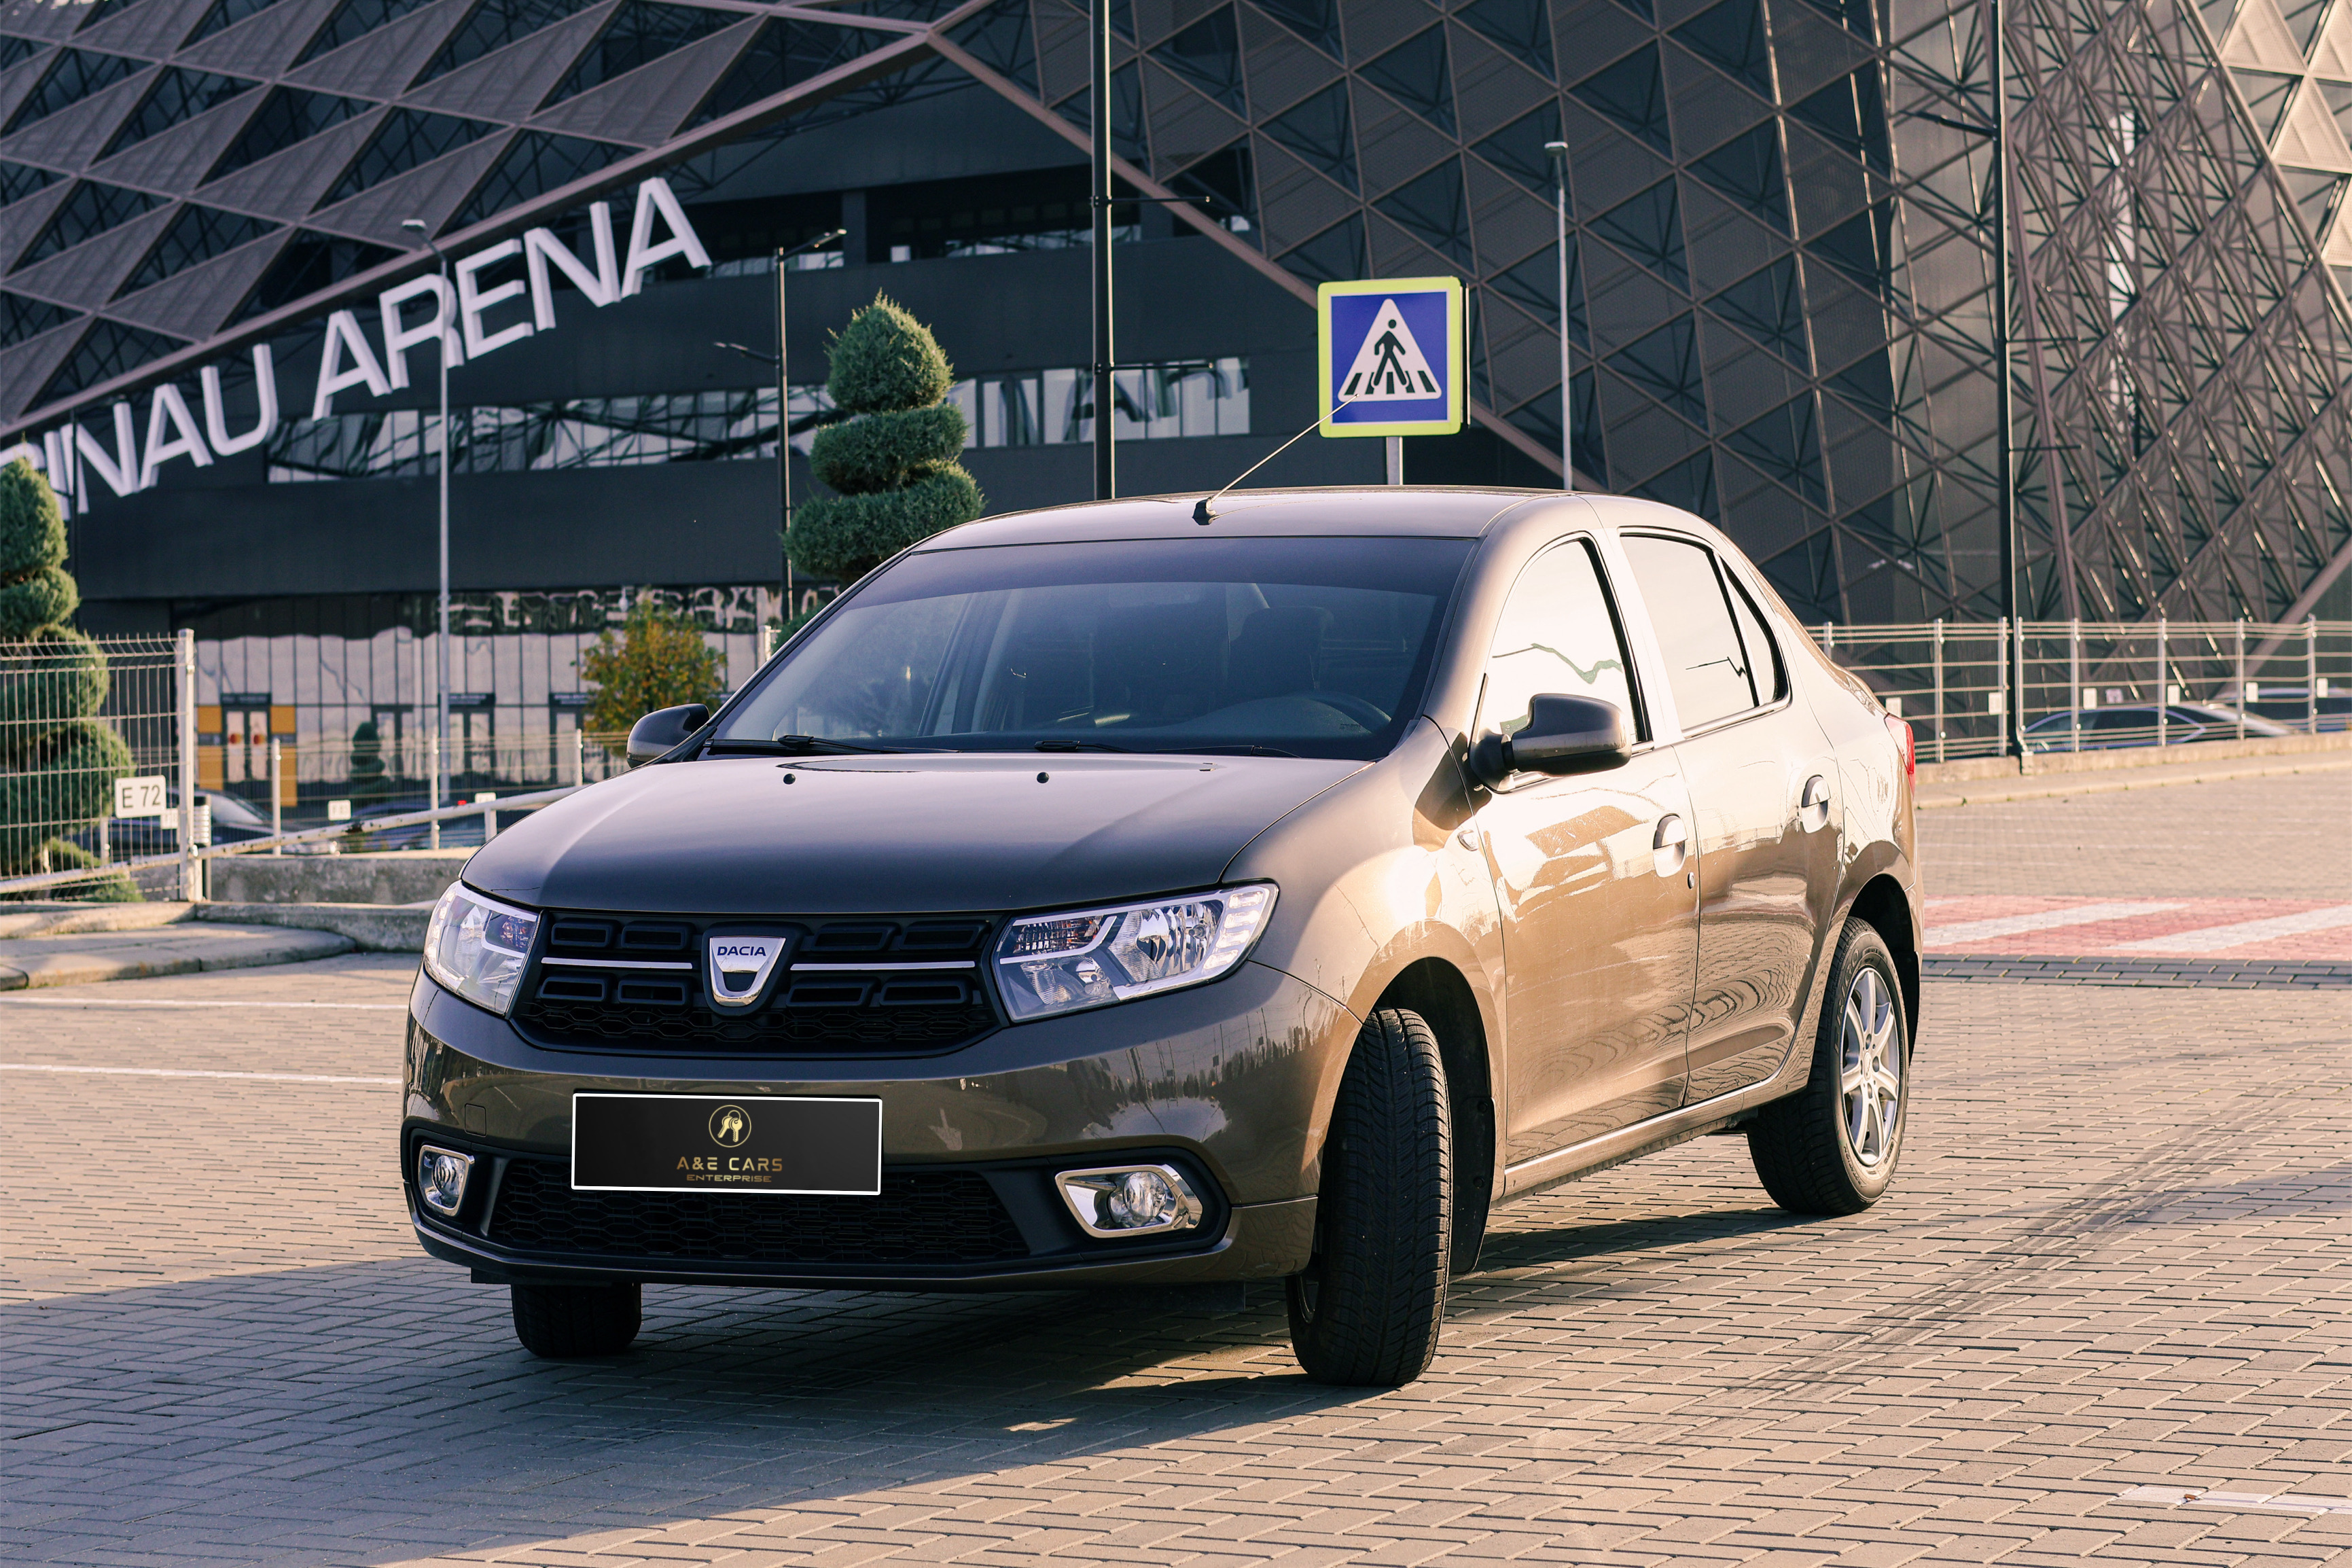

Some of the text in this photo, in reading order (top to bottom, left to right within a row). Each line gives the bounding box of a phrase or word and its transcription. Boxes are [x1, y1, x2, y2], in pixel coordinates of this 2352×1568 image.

[0, 177, 712, 521] INAU ARENA
[122, 785, 160, 808] E 72
[717, 946, 766, 956] DACIA
[677, 1156, 783, 1171] A&E CARS
[686, 1174, 772, 1183] ENTERPRISE
